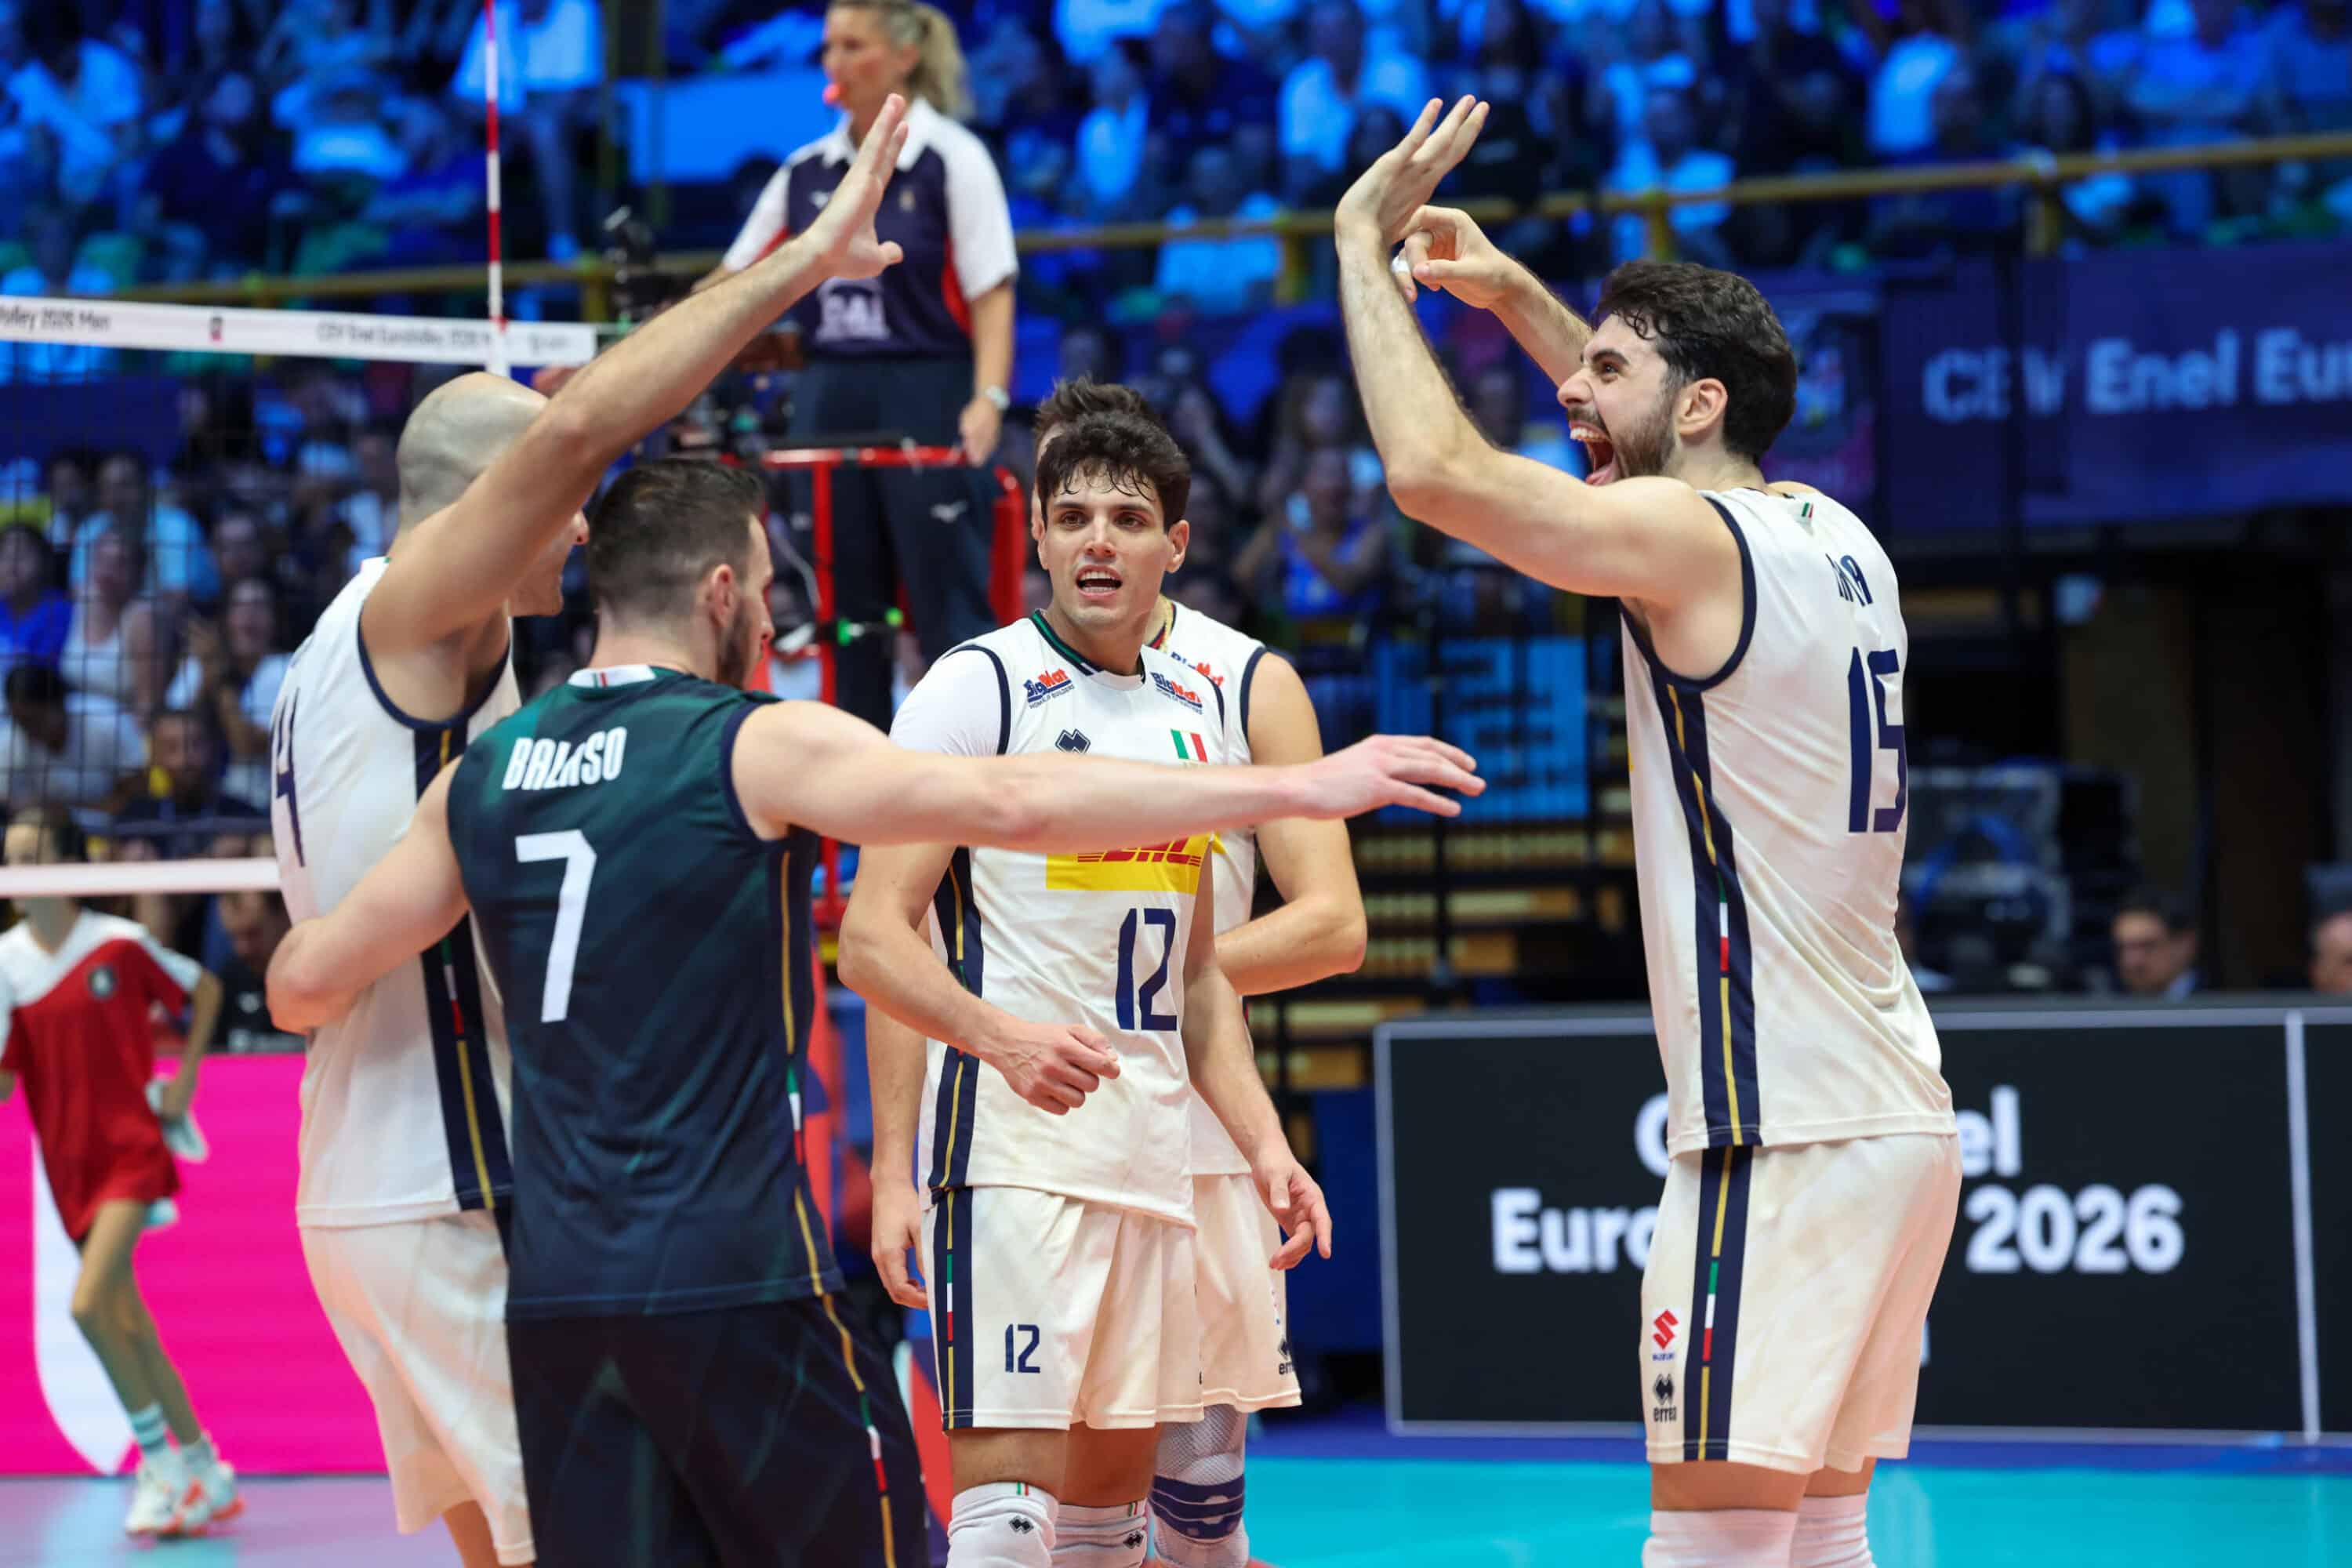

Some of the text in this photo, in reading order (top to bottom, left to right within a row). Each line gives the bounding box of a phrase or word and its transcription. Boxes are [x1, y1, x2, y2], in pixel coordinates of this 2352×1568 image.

[2088, 329, 2237, 411] Enel
[502, 726, 626, 790] BALASO
[1847, 646, 1908, 833] 15
[515, 829, 597, 1022] 7
[1116, 908, 1178, 1030] 12
[1955, 1085, 2021, 1177] el
[1964, 1184, 2185, 1273] 2026
[1005, 1323, 1040, 1374] 12
